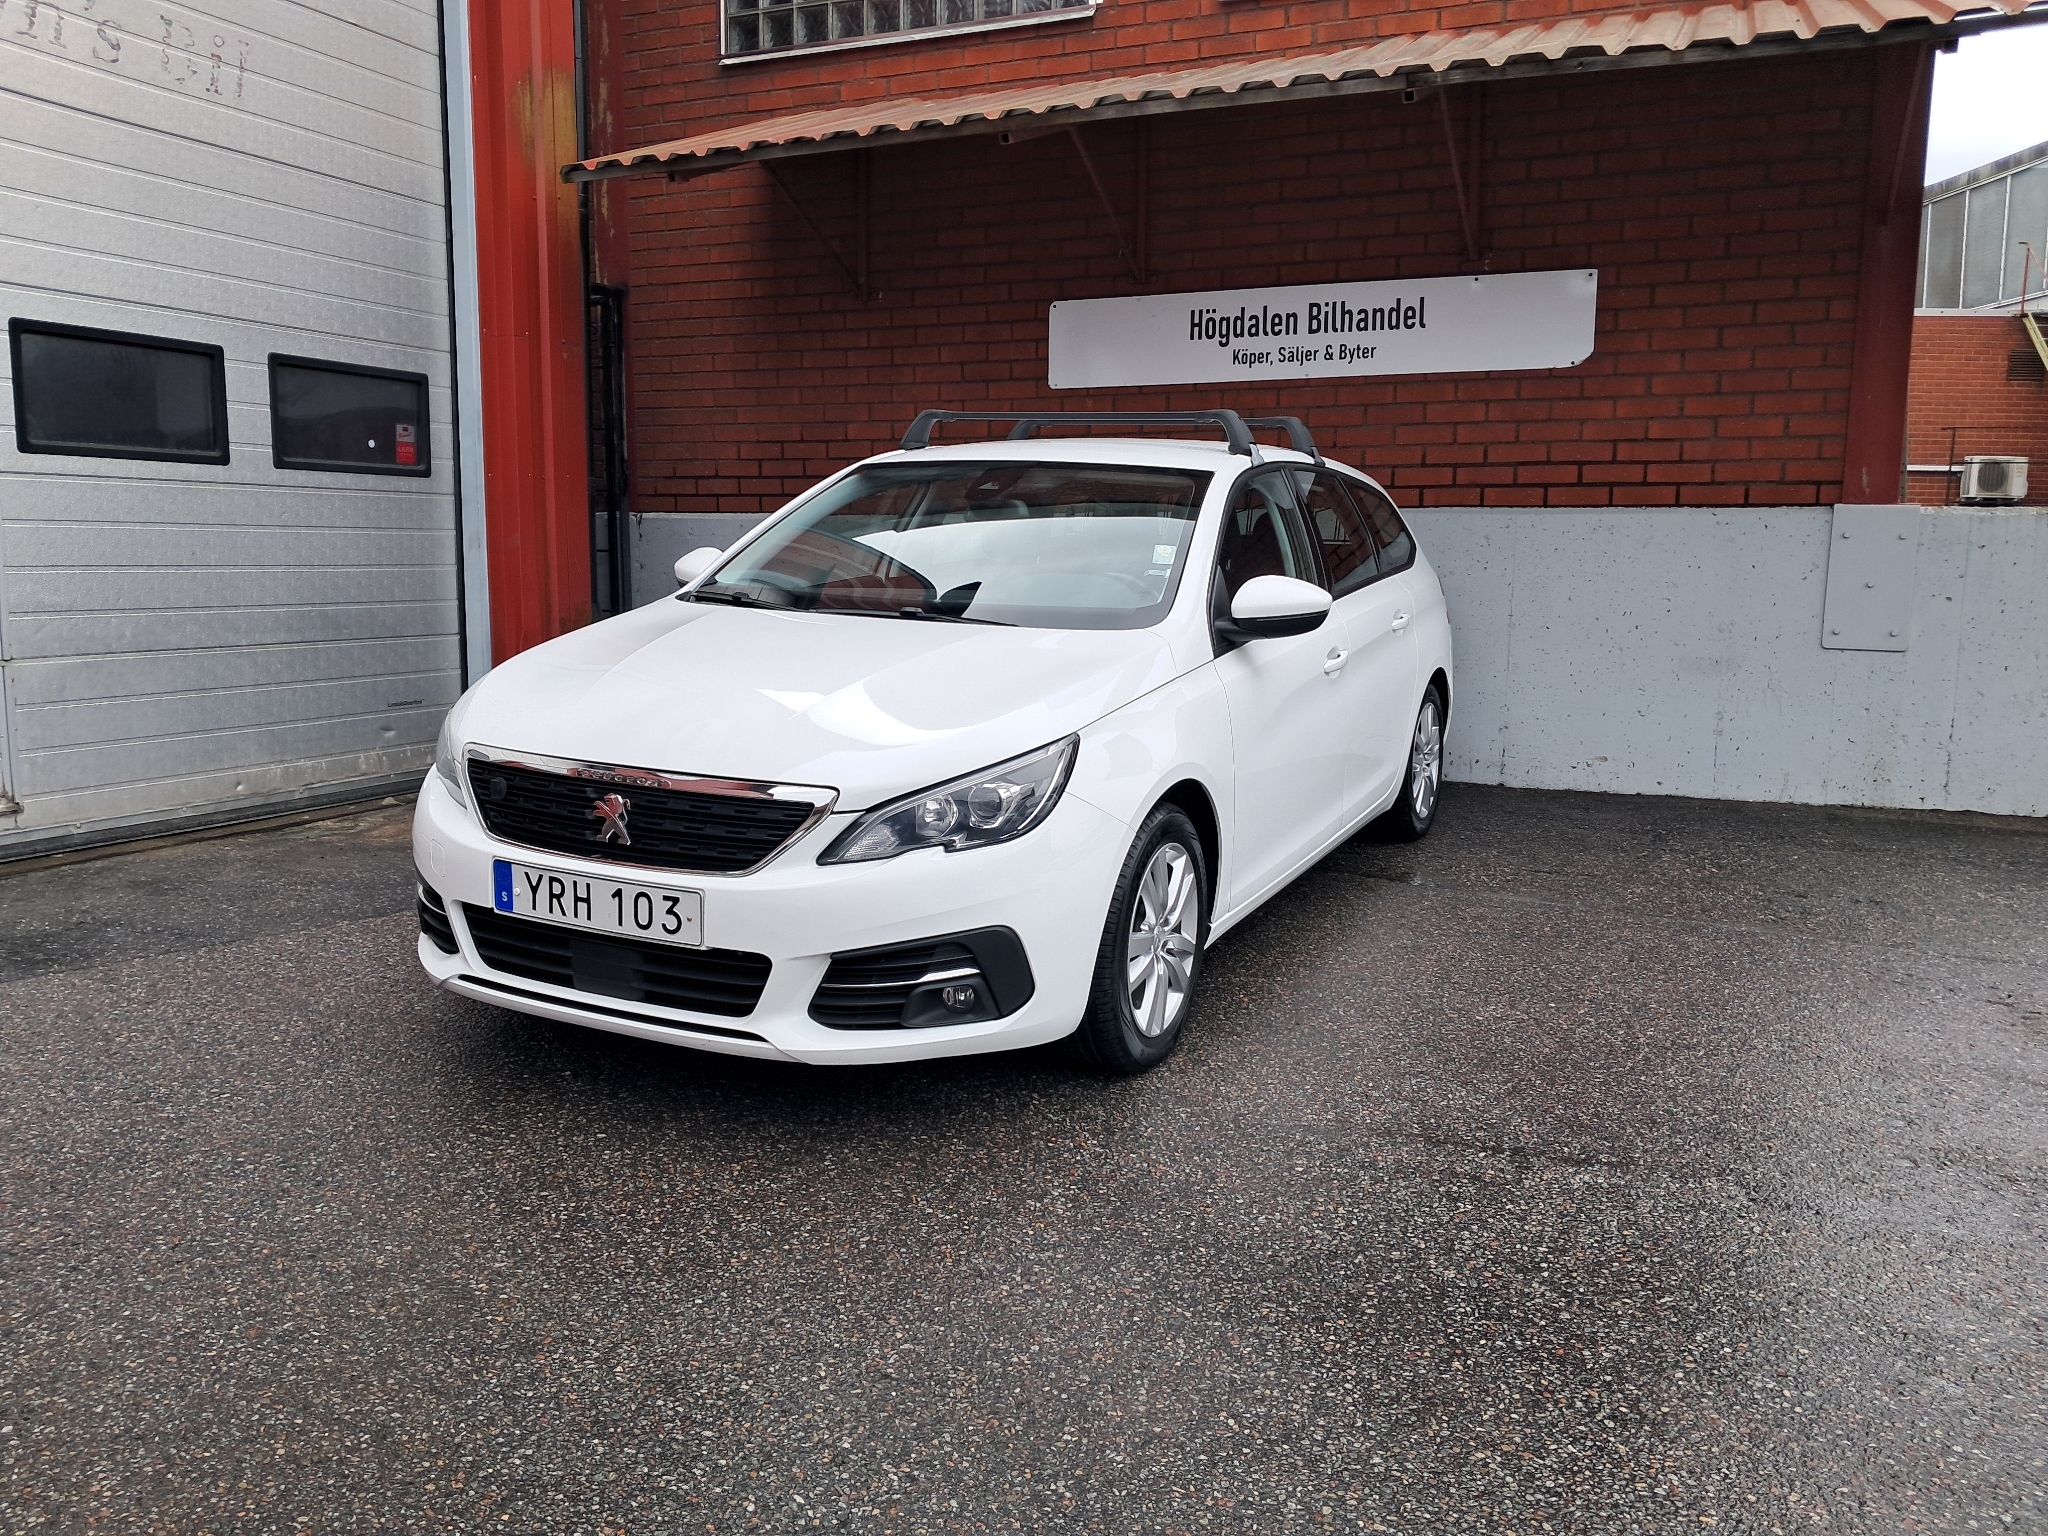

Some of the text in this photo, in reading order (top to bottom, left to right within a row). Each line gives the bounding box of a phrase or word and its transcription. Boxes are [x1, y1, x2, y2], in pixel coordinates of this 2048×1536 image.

[1190, 297, 1426, 347] Högdalen Bilhandel
[1232, 343, 1377, 368] Köper, Säljer & Byter
[501, 891, 508, 902] S
[524, 871, 682, 935] YRH 103
